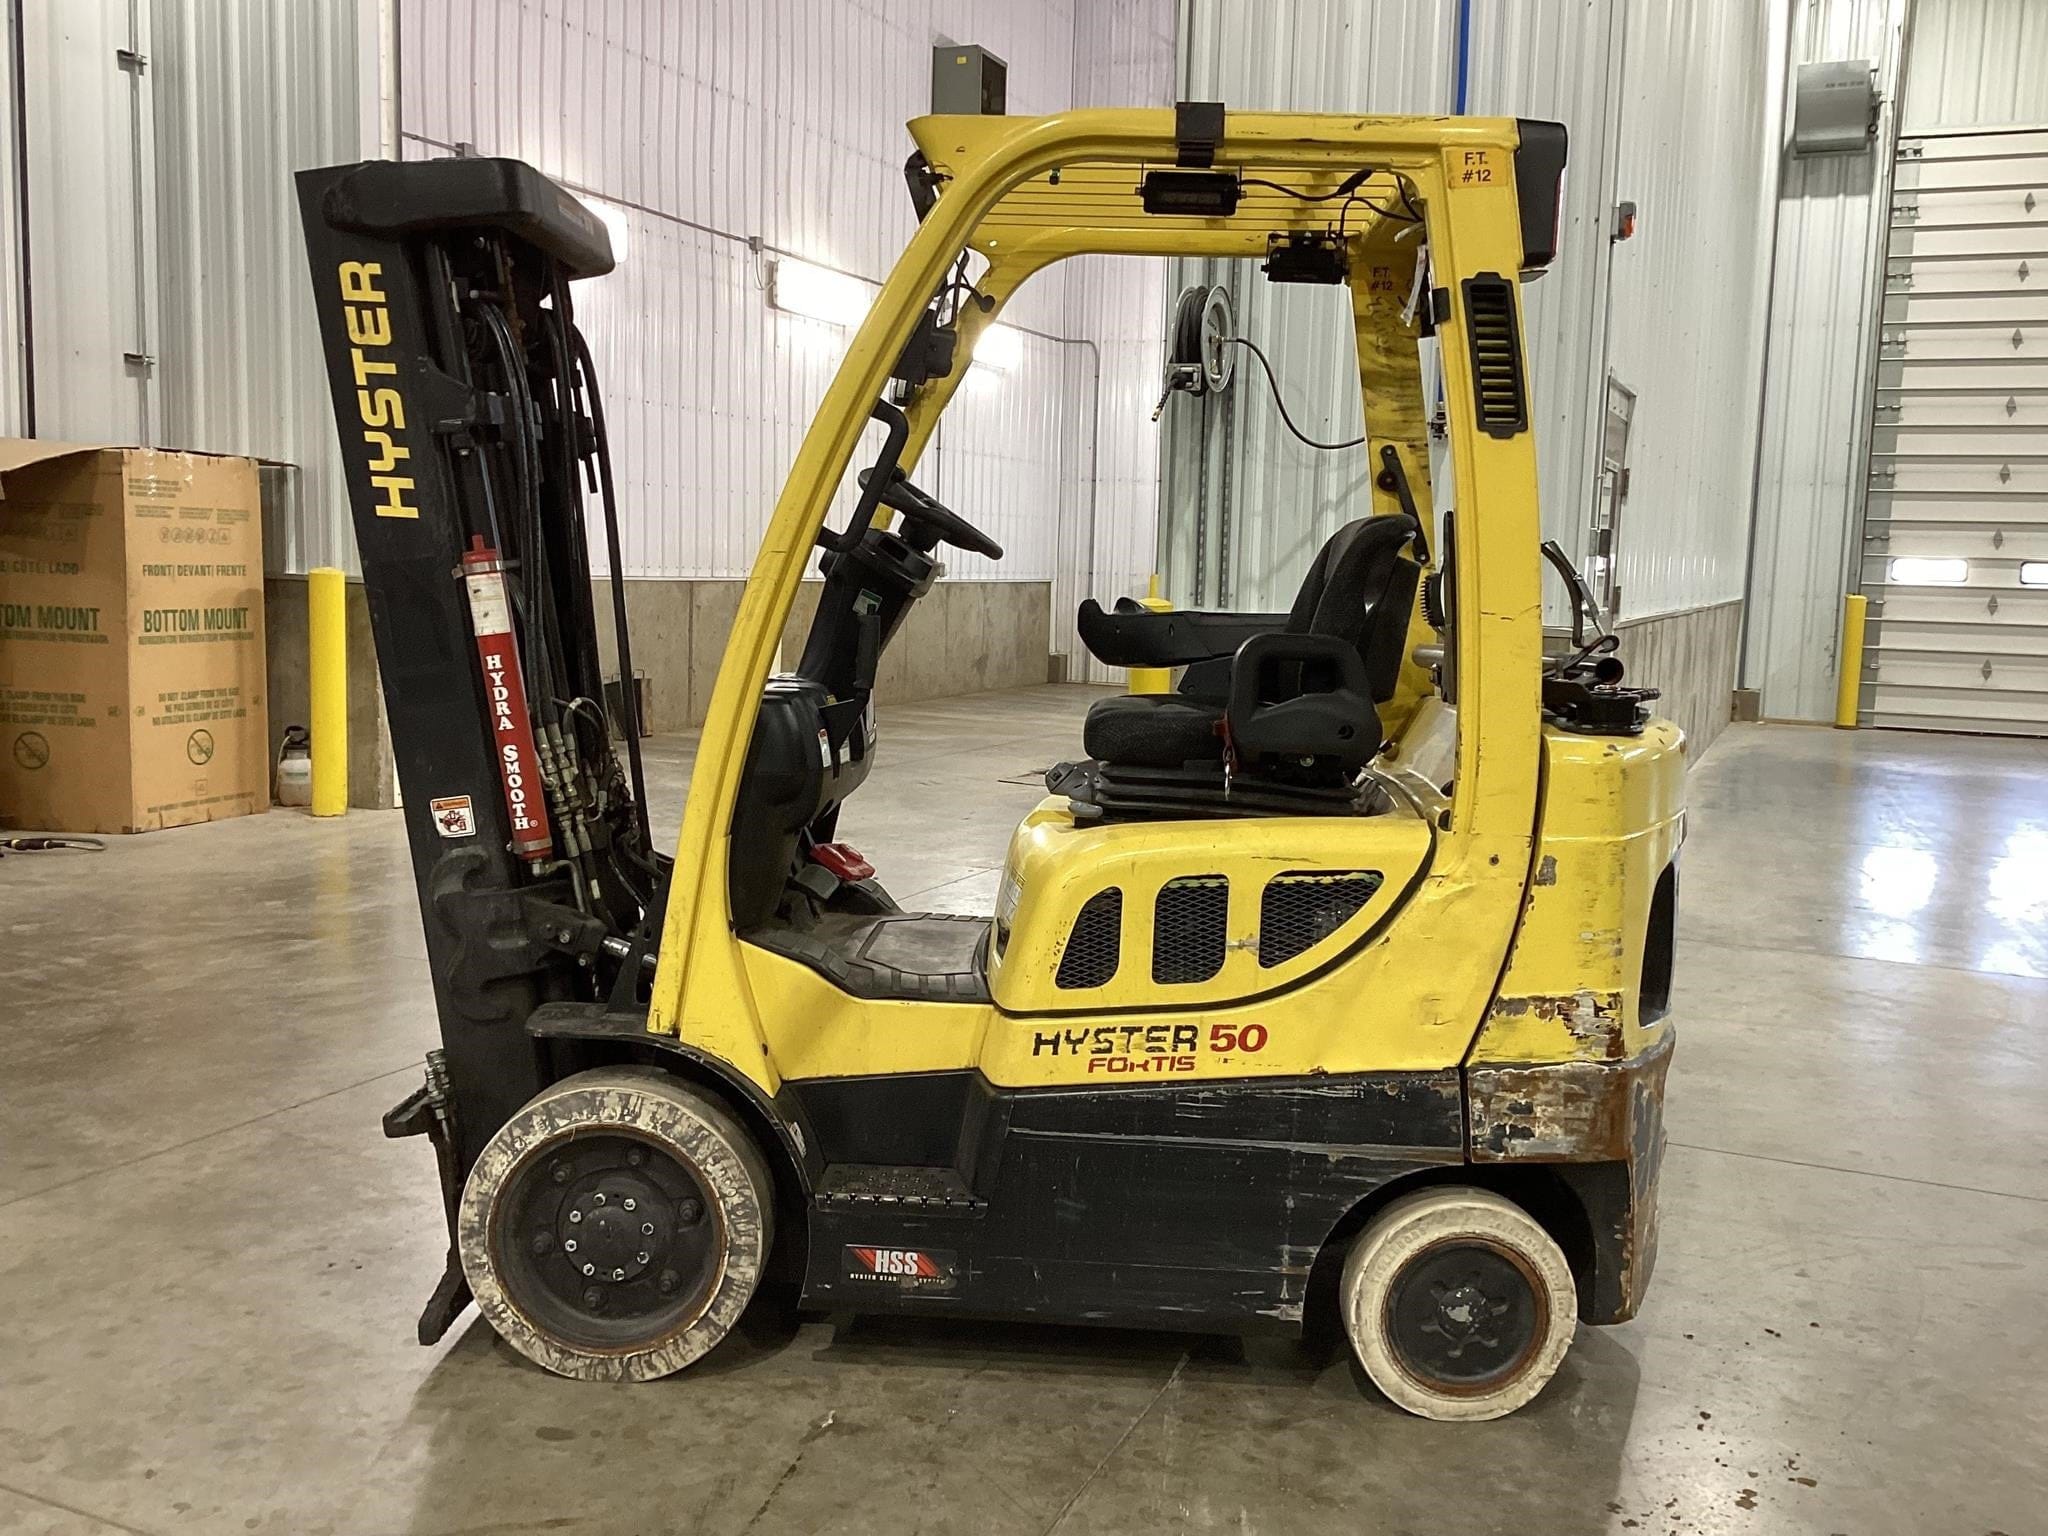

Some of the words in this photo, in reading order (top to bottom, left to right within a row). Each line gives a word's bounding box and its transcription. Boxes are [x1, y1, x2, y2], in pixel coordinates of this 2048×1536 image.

[1464, 151, 1488, 166] F.T.
[1462, 169, 1491, 183] #12
[338, 261, 420, 519] HYSTER
[216, 564, 247, 577] FRENTE
[37, 605, 100, 631] MOUNT
[143, 608, 199, 633] BOTTOM
[203, 607, 248, 630] MOUNT
[485, 654, 515, 731] HYDRA
[1033, 1025, 1199, 1056] HYSTER
[1209, 1024, 1268, 1052] 50
[875, 1250, 919, 1275] HSS
